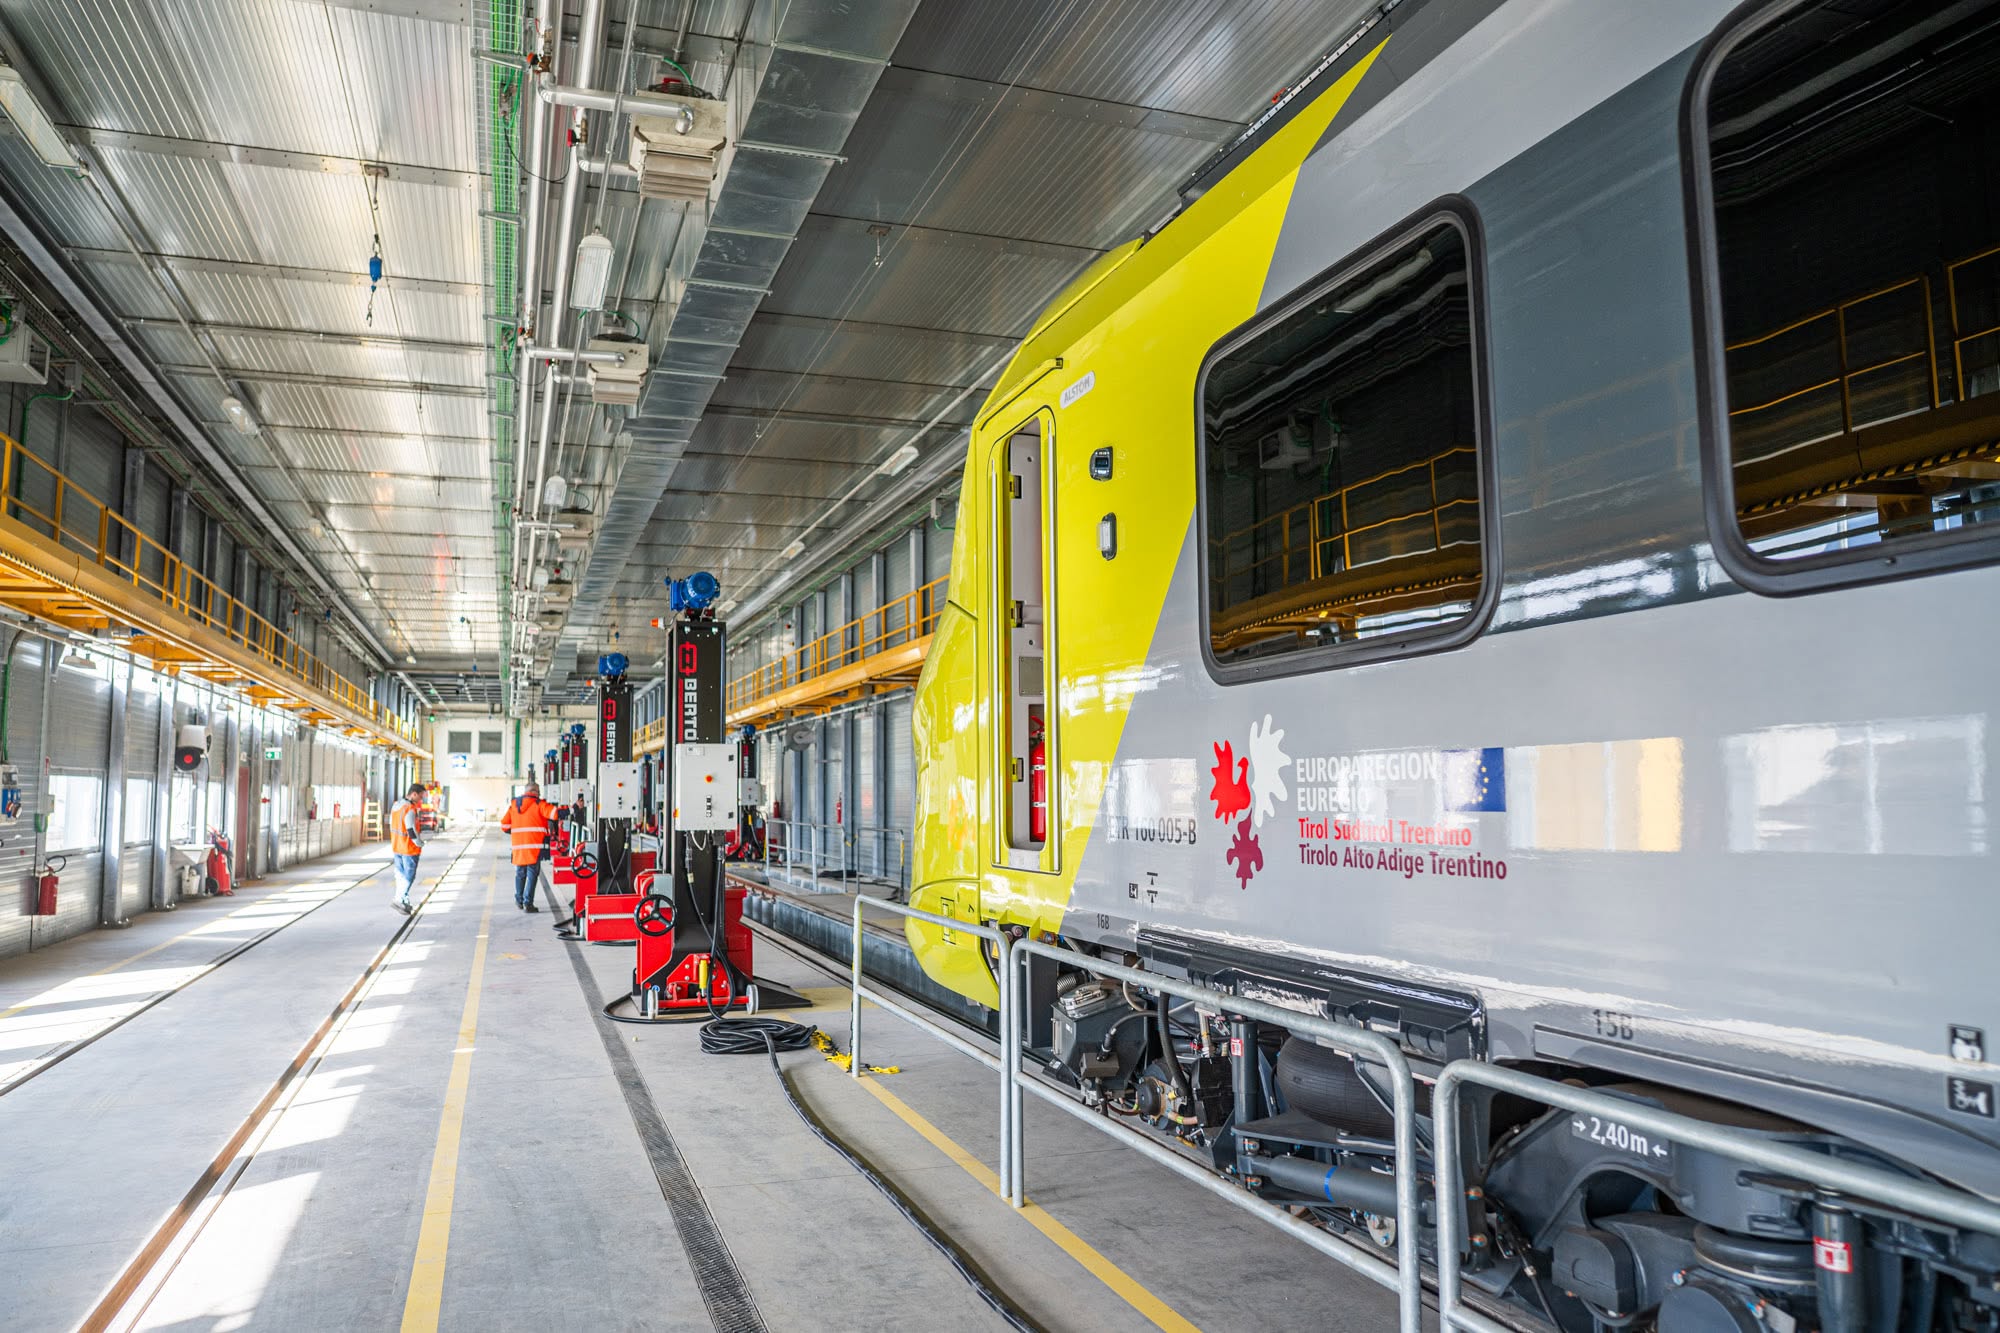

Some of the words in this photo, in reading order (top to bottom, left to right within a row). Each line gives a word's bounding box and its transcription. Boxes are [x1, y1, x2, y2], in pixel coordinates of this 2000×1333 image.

[1064, 375, 1091, 403] ALSTOM
[684, 678, 698, 742] BERTO
[606, 721, 616, 762] BERTO
[1296, 752, 1439, 783] EUROPAREGION
[1297, 786, 1370, 812] EUREGIO
[1158, 817, 1197, 845] 005-B
[1298, 817, 1329, 840] Tirol
[1333, 818, 1394, 843] Südtirol
[1398, 819, 1473, 846] Trentino
[1298, 843, 1338, 867] Tirolo
[1342, 846, 1374, 869] Alto
[1376, 848, 1425, 880] Adige
[1429, 851, 1508, 880] Trentino
[1590, 1116, 1649, 1157] 2,40m
